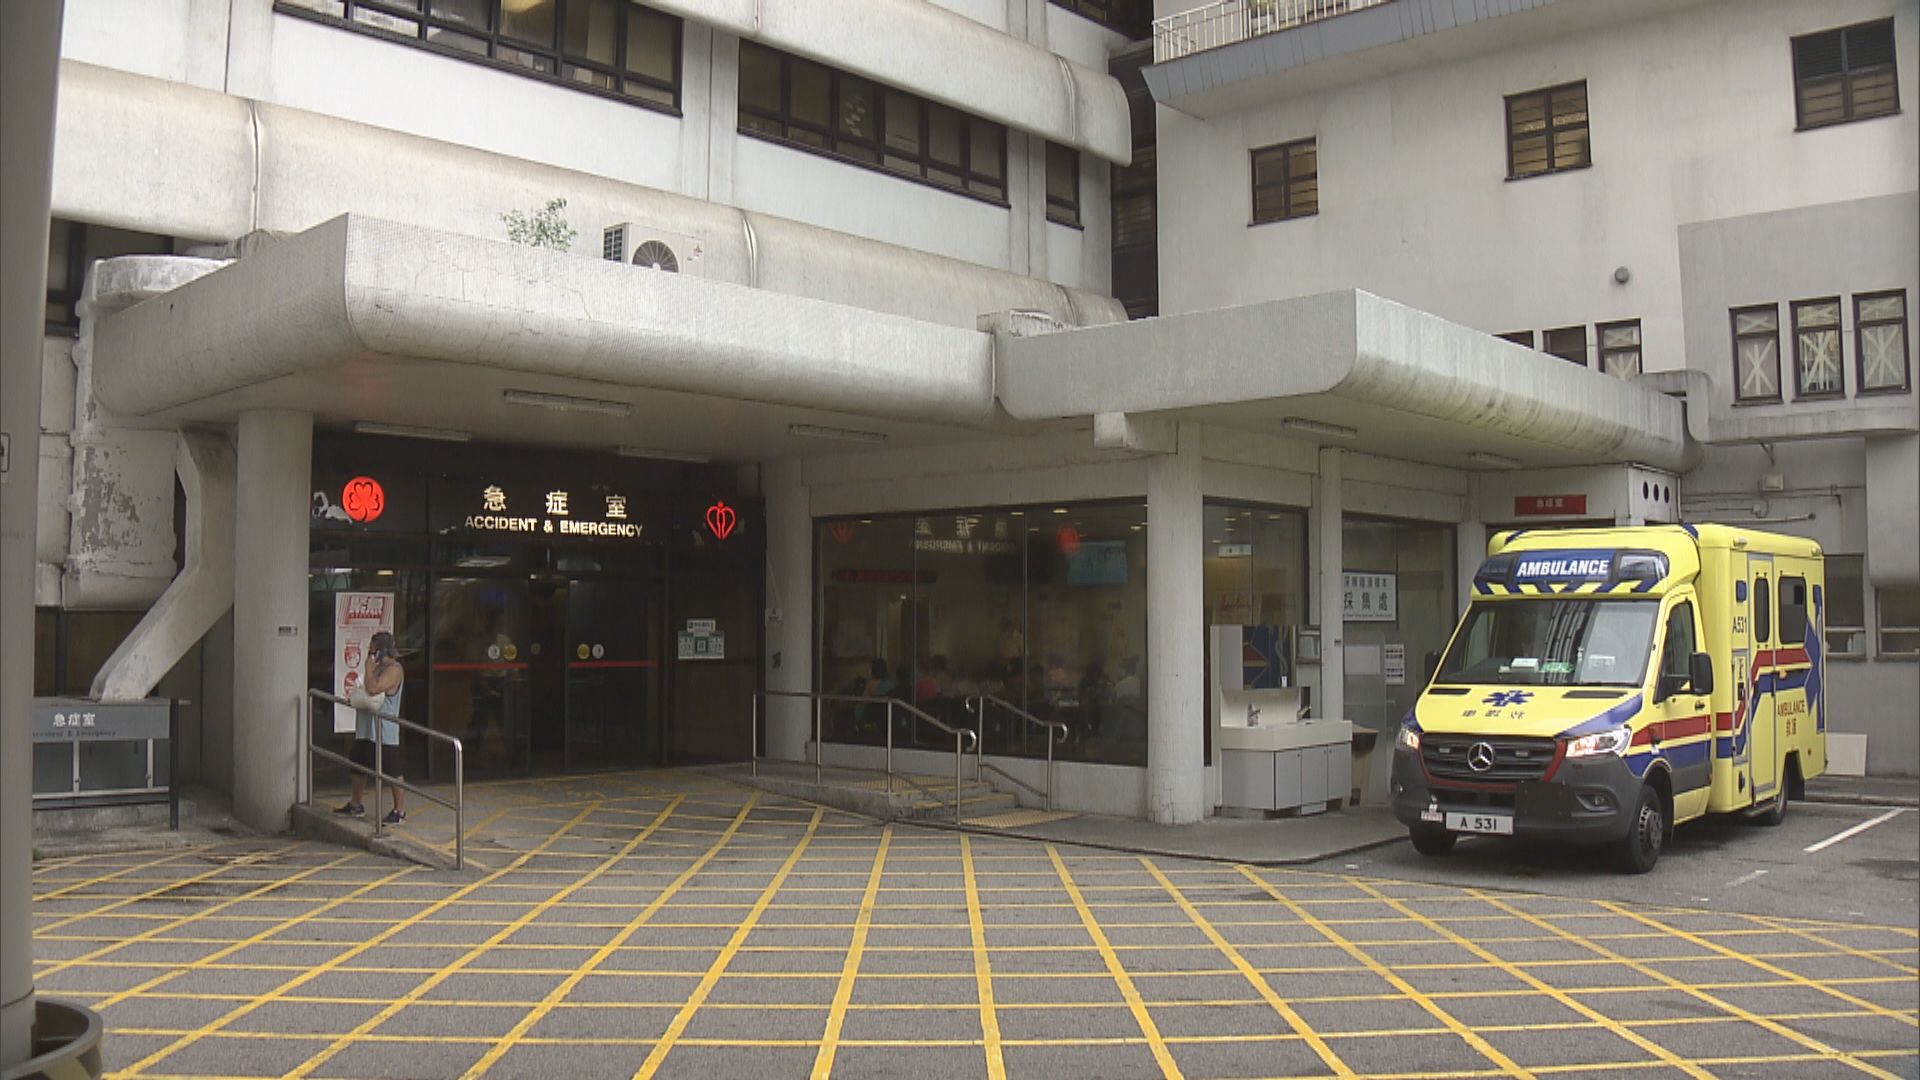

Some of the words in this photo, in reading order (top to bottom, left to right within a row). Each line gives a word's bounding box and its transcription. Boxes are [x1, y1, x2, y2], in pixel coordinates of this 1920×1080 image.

[484, 485, 627, 519] 急症室
[464, 516, 538, 532] ACCIDENT
[543, 520, 554, 533] &
[560, 520, 643, 537] EMERGENCY
[1516, 560, 1610, 577] AMBULANCE
[1732, 616, 1747, 633] A531
[1777, 700, 1806, 717] AMBULANCE
[53, 712, 96, 728] 急症室
[1460, 816, 1468, 829] A
[1474, 817, 1497, 831] 531
